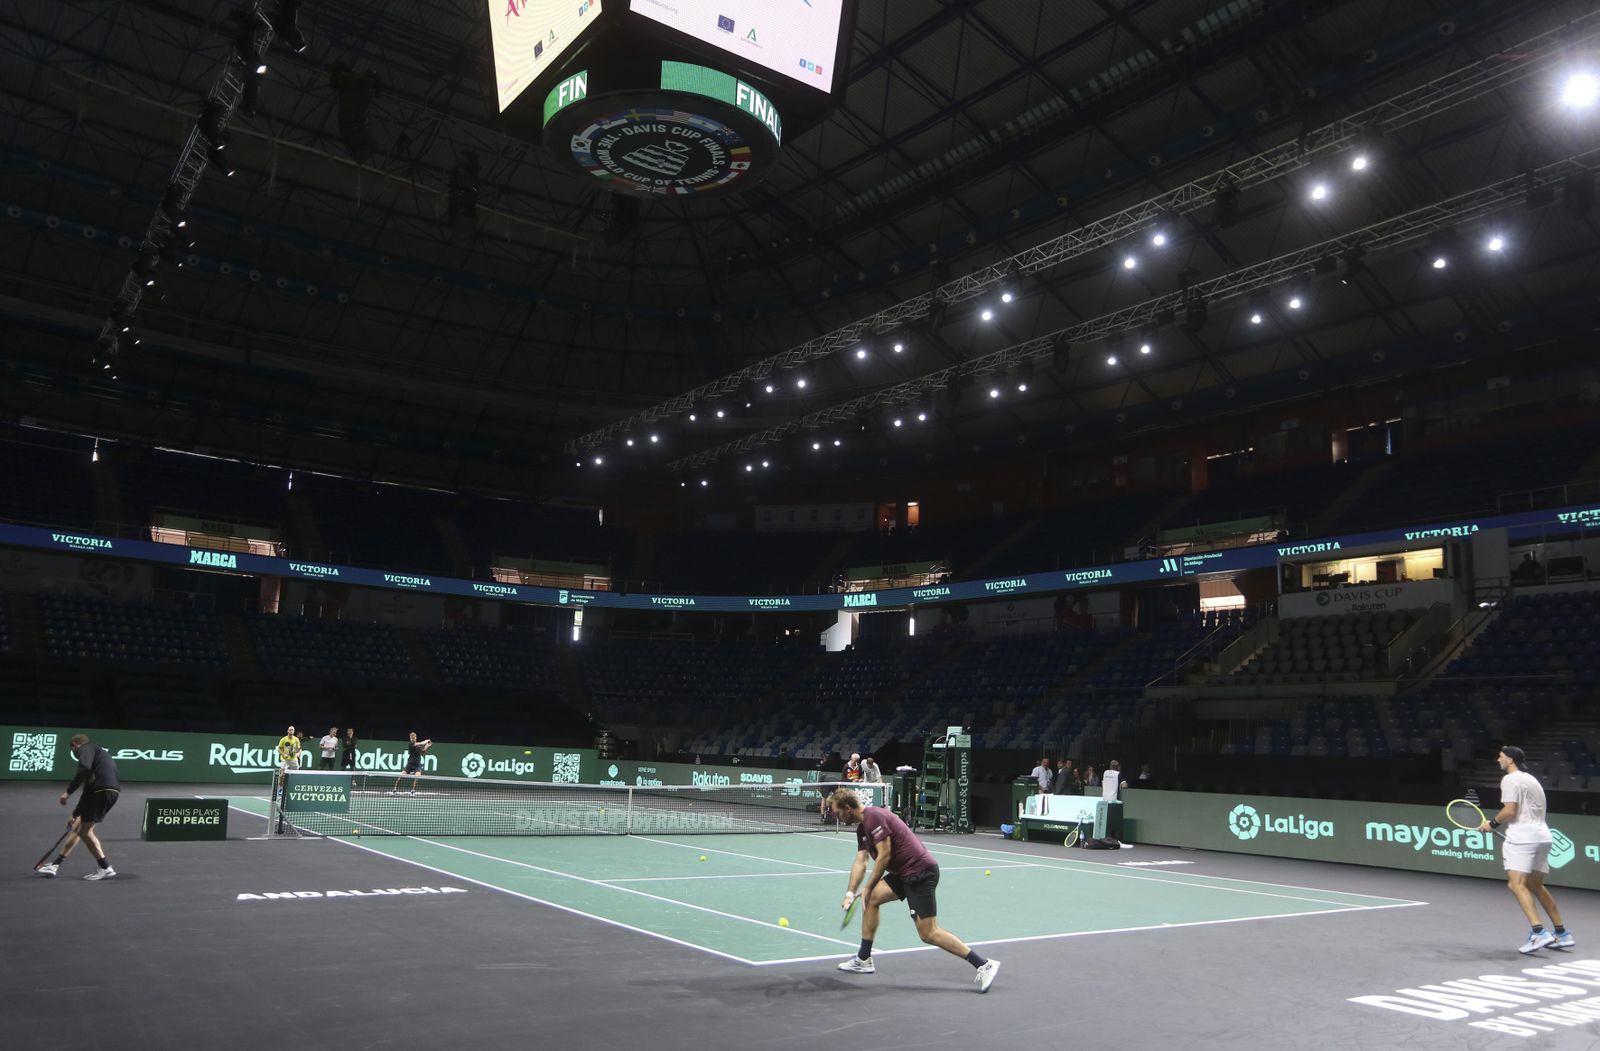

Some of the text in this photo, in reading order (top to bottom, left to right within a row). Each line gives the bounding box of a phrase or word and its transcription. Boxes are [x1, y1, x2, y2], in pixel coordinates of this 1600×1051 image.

[622, 124, 726, 166] DAVIS CUP FINALS
[596, 149, 625, 173] WORLD
[623, 172, 651, 183] CUP
[675, 168, 720, 185] TENNIS
[52, 534, 112, 548] VICTORIA
[1278, 542, 1340, 556] VICTORIA
[190, 550, 237, 569] MARCA
[289, 563, 339, 576] VICTORIA
[1066, 569, 1112, 582] VICTORIA
[384, 574, 431, 586] VICTORIA
[985, 579, 1026, 590] VICTORIA
[473, 584, 517, 595] VICTORIA
[913, 587, 950, 598] VICTORIA
[1334, 588, 1403, 602] DAVIS CUP
[652, 597, 695, 605] VICTORIA
[844, 593, 877, 607] MARCA
[1351, 602, 1386, 612] Rakuten
[209, 743, 312, 767] Rakutn
[488, 758, 534, 775] LaLiga
[692, 771, 731, 787] Rakuten
[294, 785, 344, 793] CERVEZAS
[289, 793, 347, 802] VICTORIA
[158, 808, 220, 816] TENNIS PLAYS
[157, 816, 220, 825] FOR PEACE
[1265, 814, 1334, 839] LaLiga
[1366, 821, 1494, 851] mayoral
[1431, 848, 1495, 861] making friends
[1345, 974, 1588, 1020] DAVIS
[1467, 1015, 1555, 1037] BY
